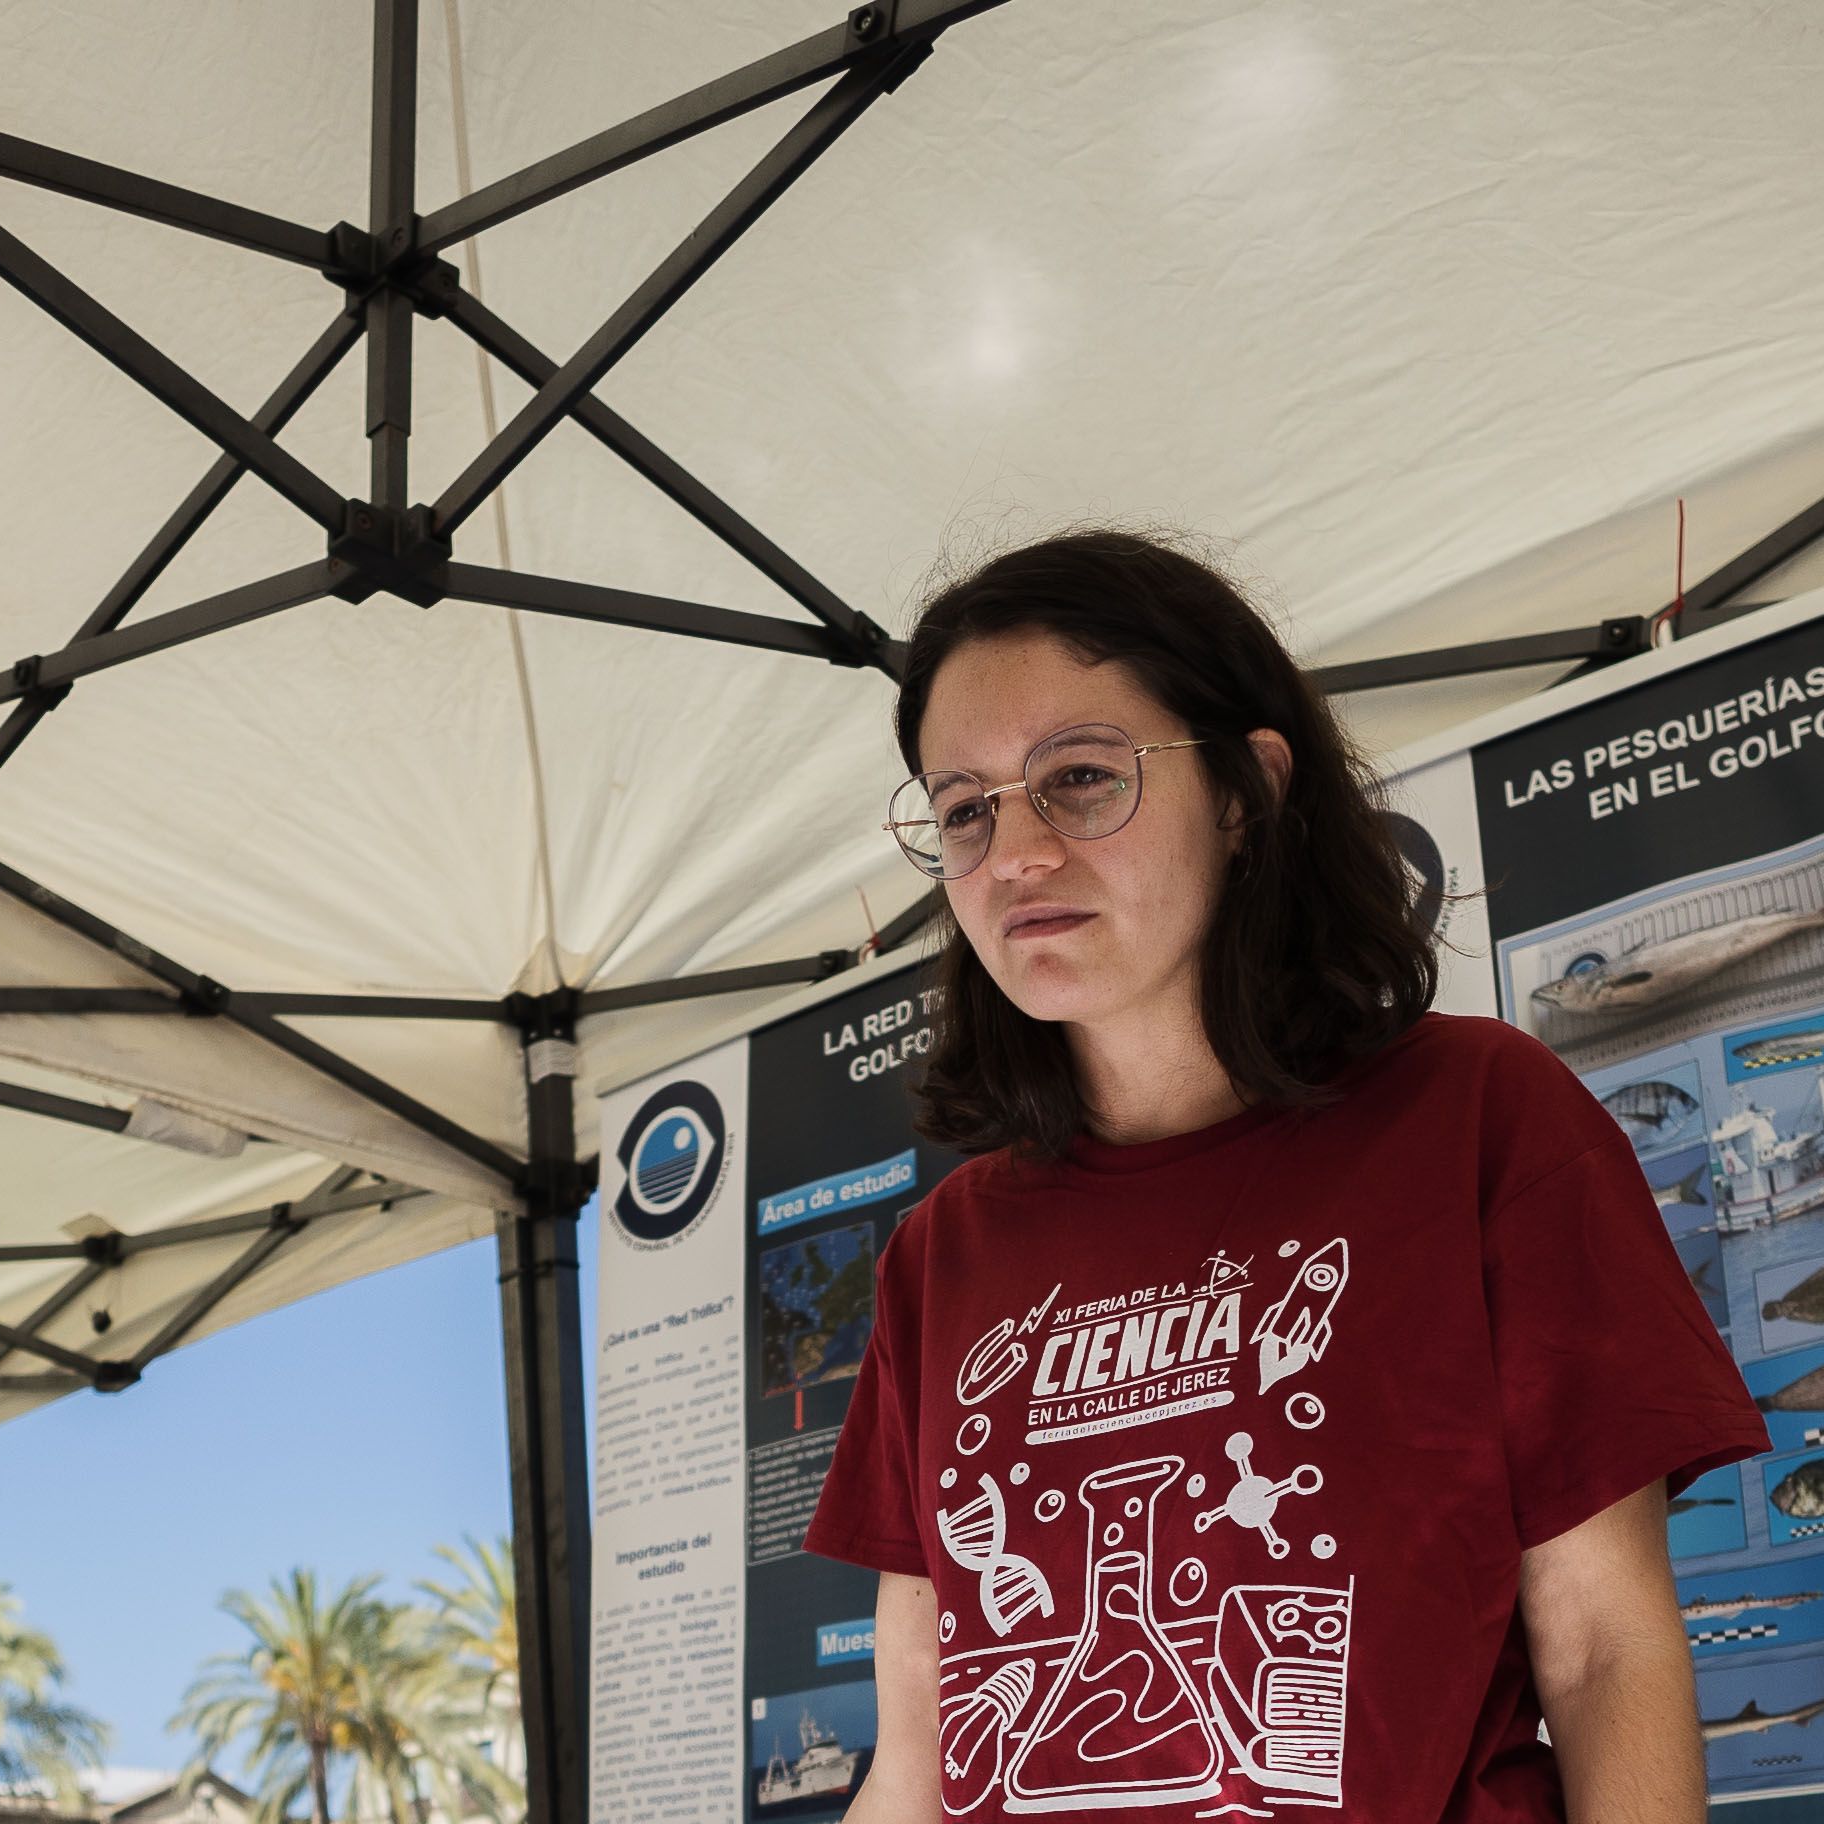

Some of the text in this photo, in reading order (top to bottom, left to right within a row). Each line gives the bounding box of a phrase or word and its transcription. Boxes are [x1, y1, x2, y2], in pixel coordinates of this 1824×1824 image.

[1504, 759, 1575, 808] LAS
[1588, 776, 1639, 820] EN
[1649, 761, 1701, 798] EL
[824, 1023, 859, 1056] LA
[862, 1000, 914, 1041] RED
[848, 1027, 932, 1082] GOLFO
[760, 1163, 912, 1226] Área de estudio
[1052, 1282, 1187, 1325] XI FERIA DE LA
[1032, 1293, 1242, 1397] CIENCIA
[1027, 1367, 1231, 1426] EN LA CALLE DE JEREZ
[615, 1533, 712, 1565] Importancia del
[637, 1559, 685, 1581] estudio
[820, 1632, 875, 1656] Mues
